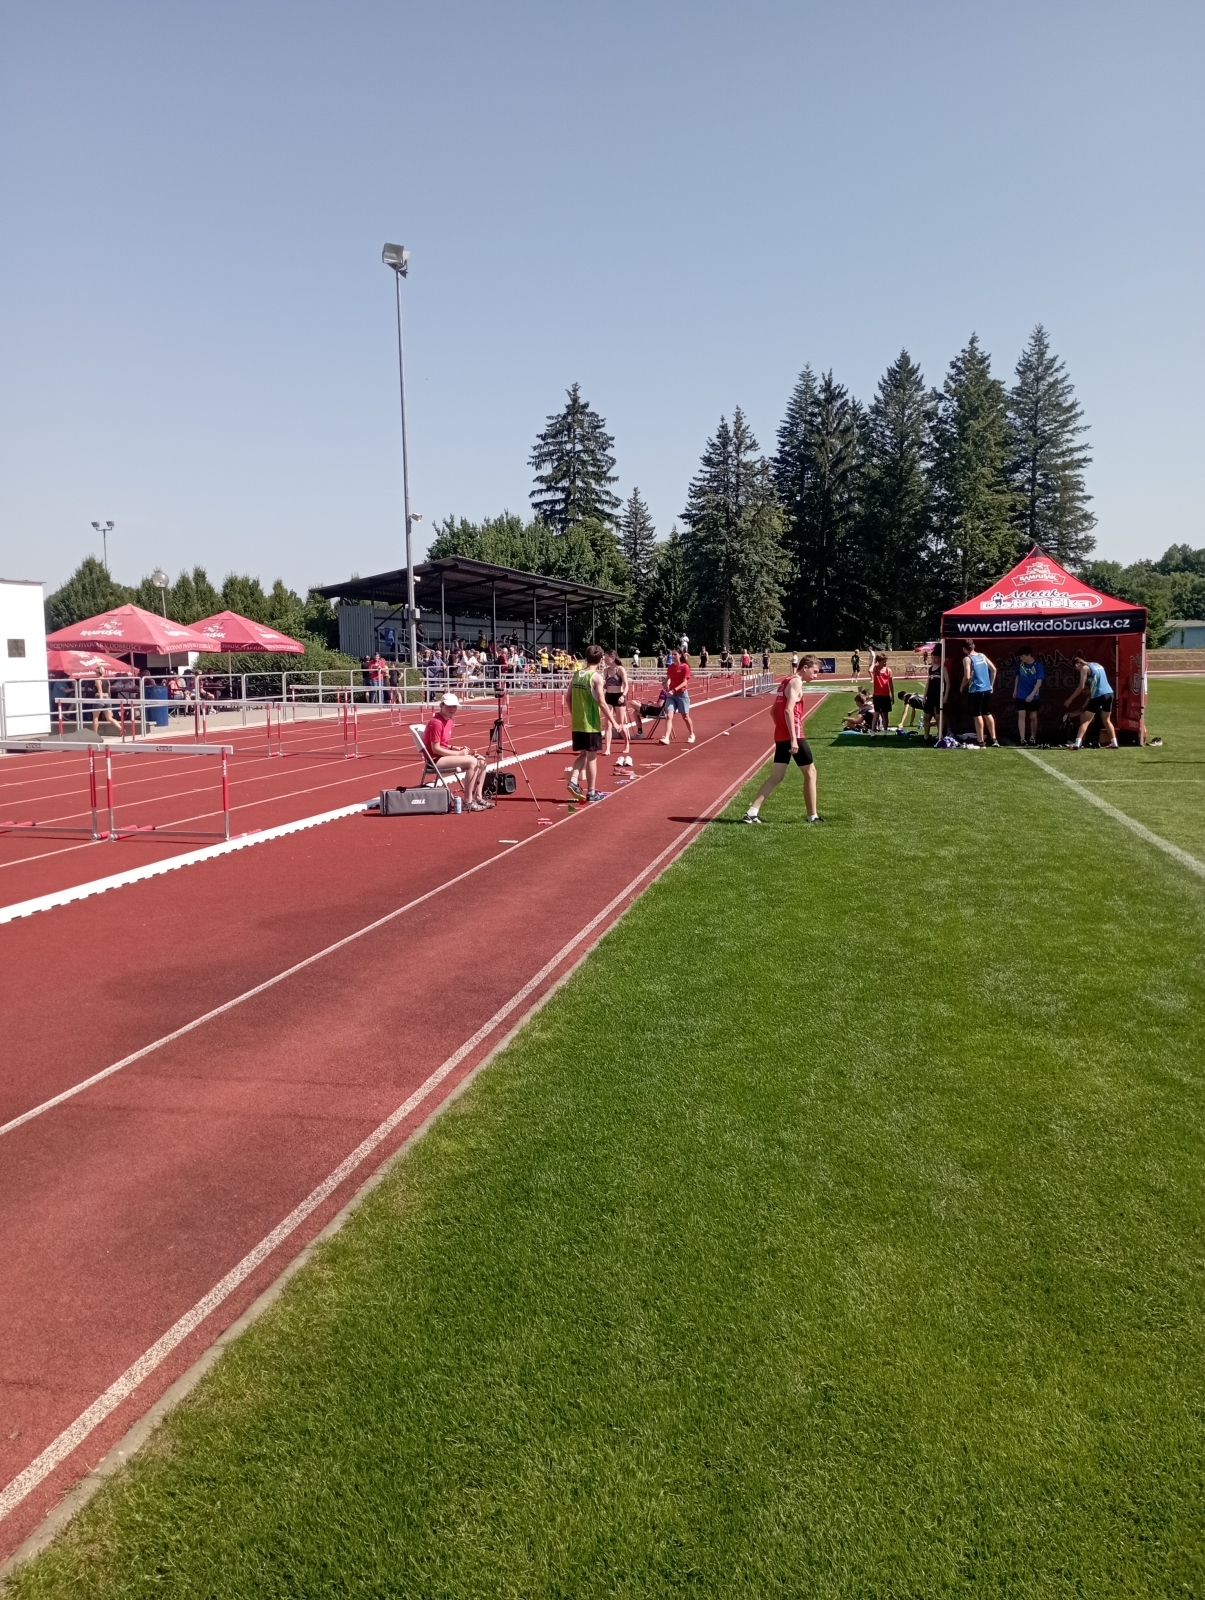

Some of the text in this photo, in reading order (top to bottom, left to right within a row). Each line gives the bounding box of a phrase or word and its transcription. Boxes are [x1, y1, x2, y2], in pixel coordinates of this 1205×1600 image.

[1009, 589, 1069, 599] Atletika
[980, 598, 1092, 610] Dobruška
[957, 618, 1131, 633] www.atletikadobruska.cz
